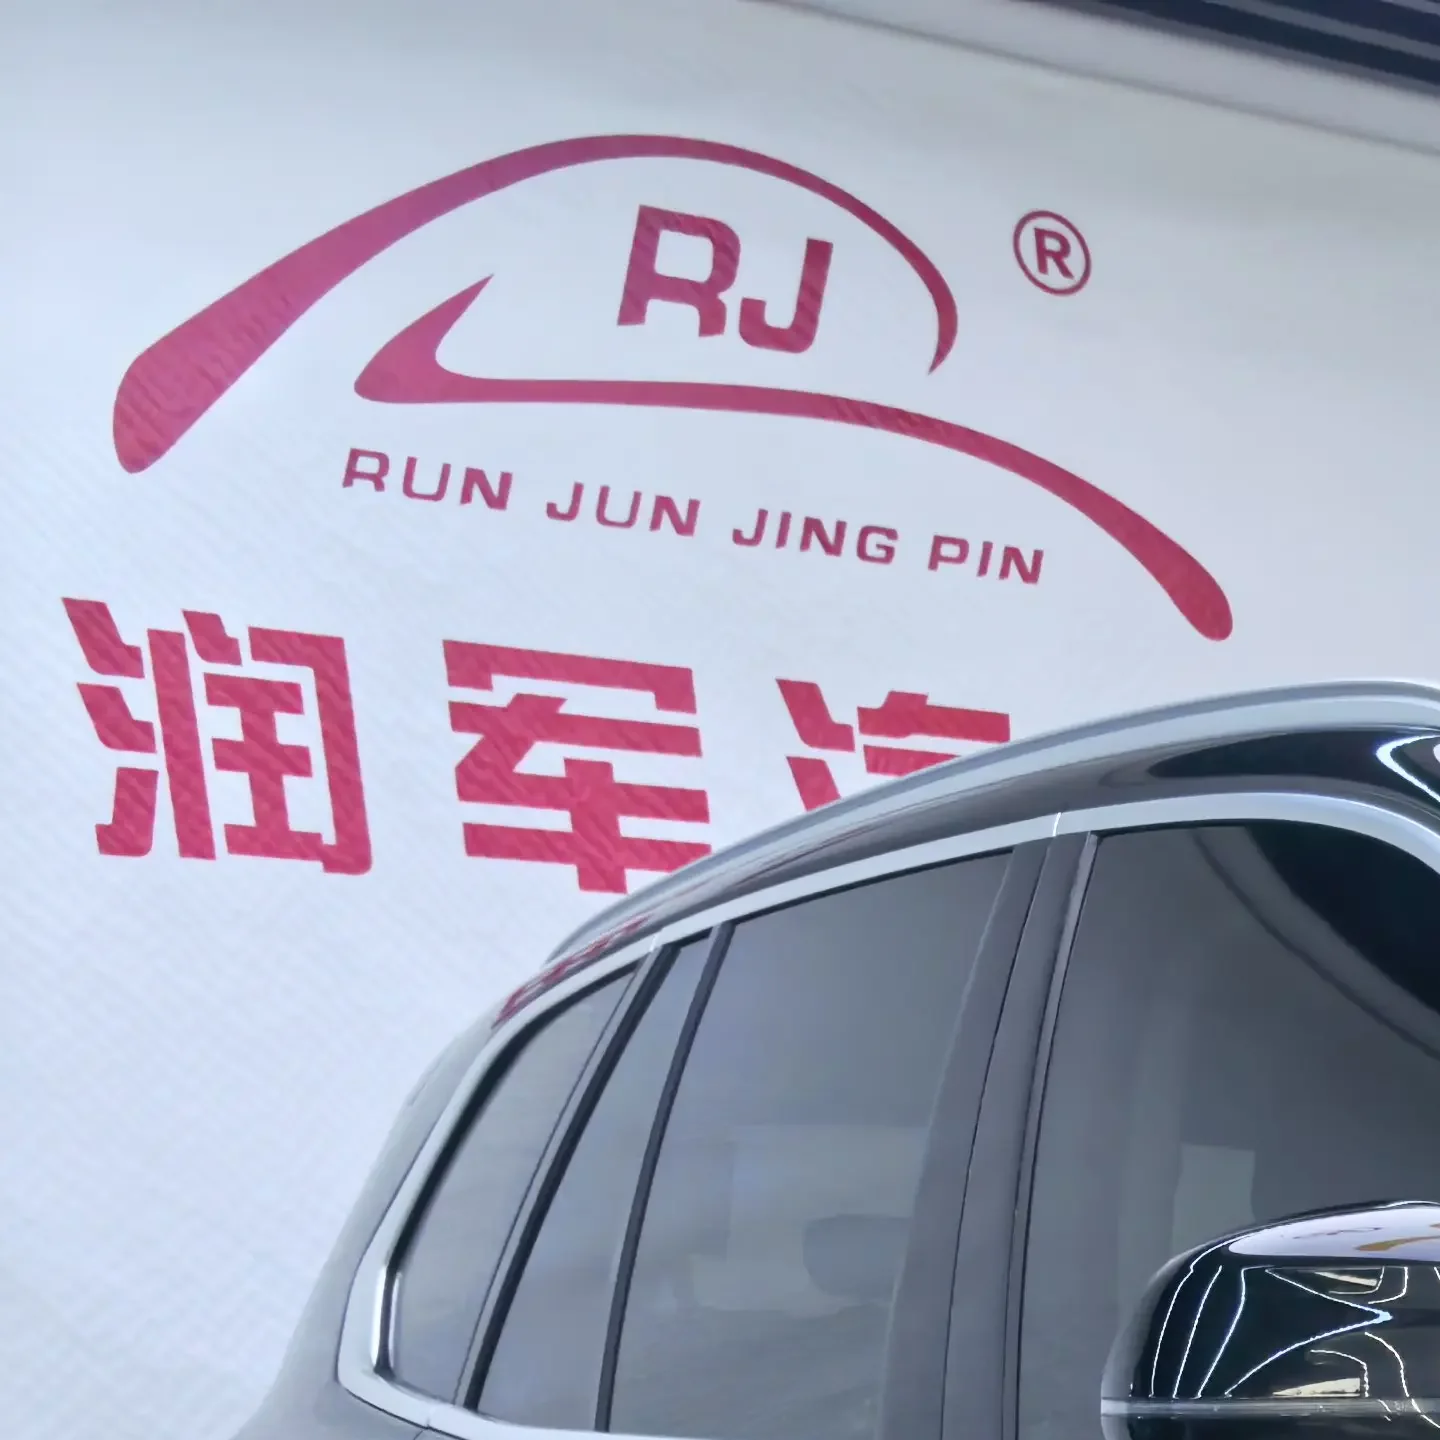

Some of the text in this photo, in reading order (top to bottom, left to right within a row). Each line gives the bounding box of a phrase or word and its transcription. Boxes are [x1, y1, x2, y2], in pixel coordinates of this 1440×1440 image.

[617, 204, 834, 355] RJ
[342, 447, 1045, 585] RUN JUN JING PIN
